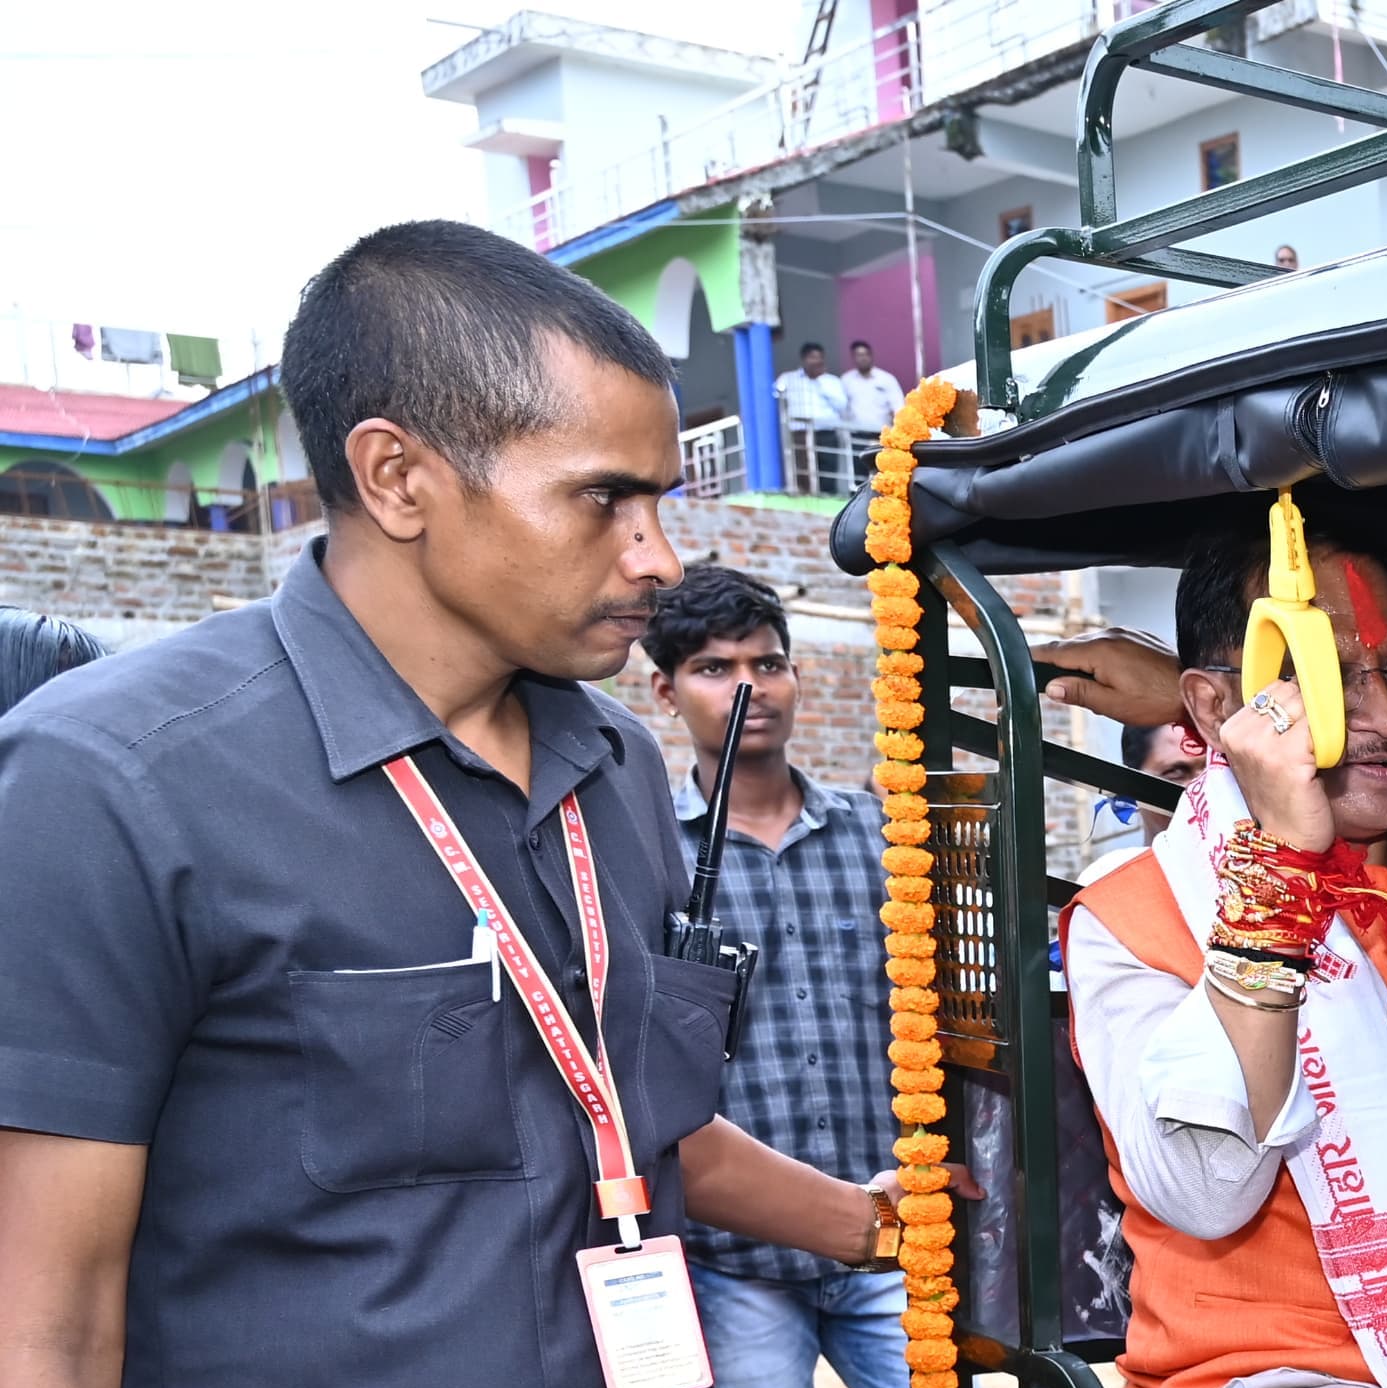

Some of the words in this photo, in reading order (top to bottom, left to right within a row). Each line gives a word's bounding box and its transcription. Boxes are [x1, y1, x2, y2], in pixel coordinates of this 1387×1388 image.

[580, 870, 602, 965] SECURITY
[471, 884, 529, 979] SECURITY
[531, 991, 609, 1125] CHHATTISGARH
